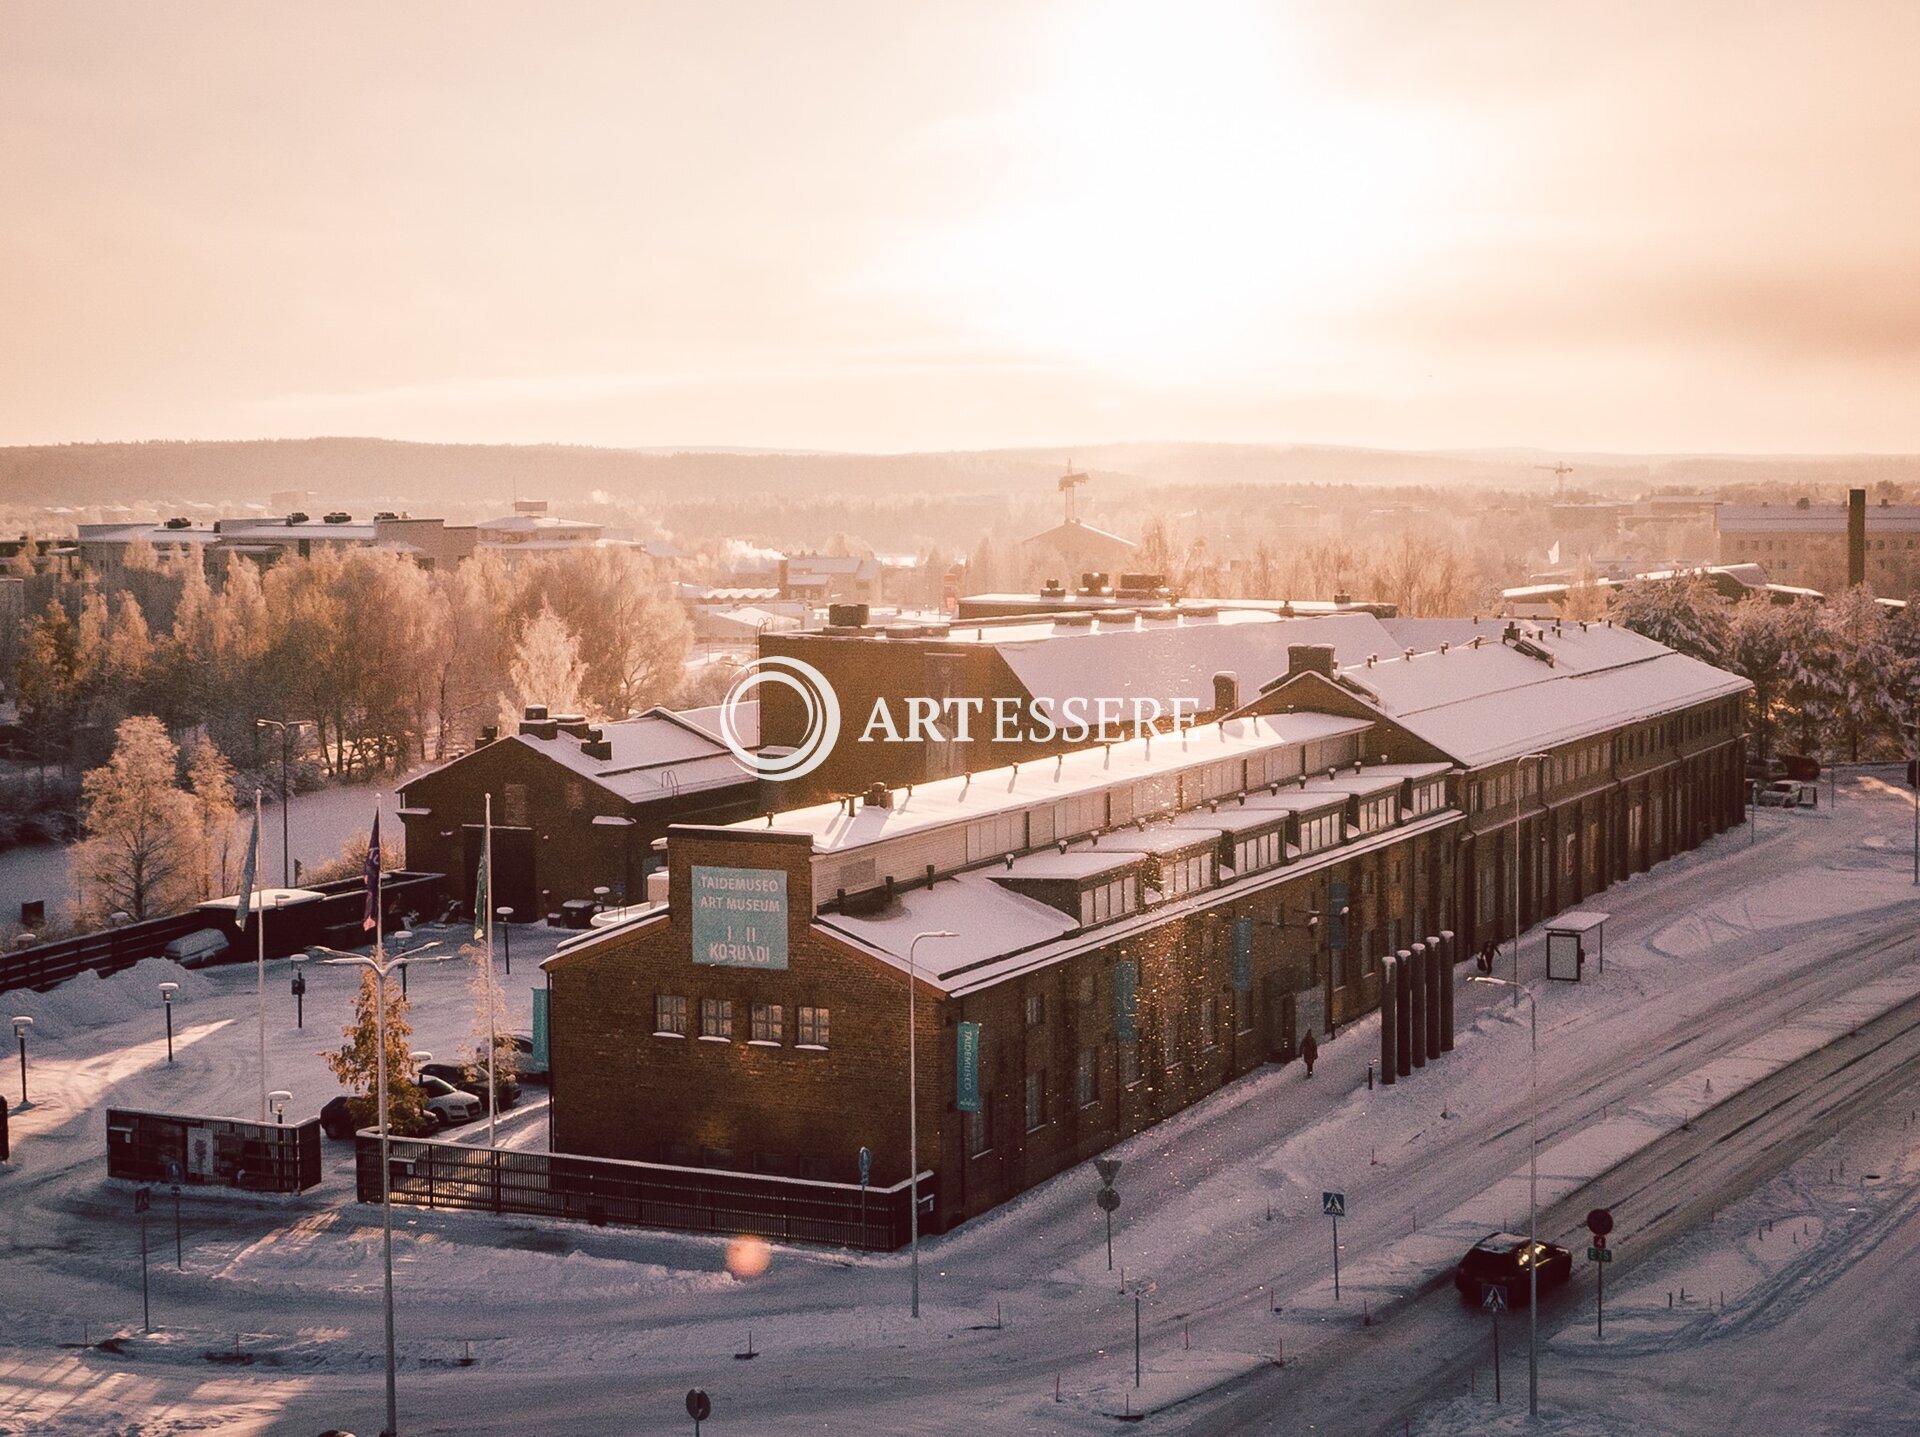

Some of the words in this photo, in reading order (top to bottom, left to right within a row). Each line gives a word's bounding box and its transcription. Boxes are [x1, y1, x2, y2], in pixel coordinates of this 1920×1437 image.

[700, 876, 778, 891] TAIDEMUSEO
[700, 896, 724, 910] ART
[726, 897, 780, 913] MUSEUM
